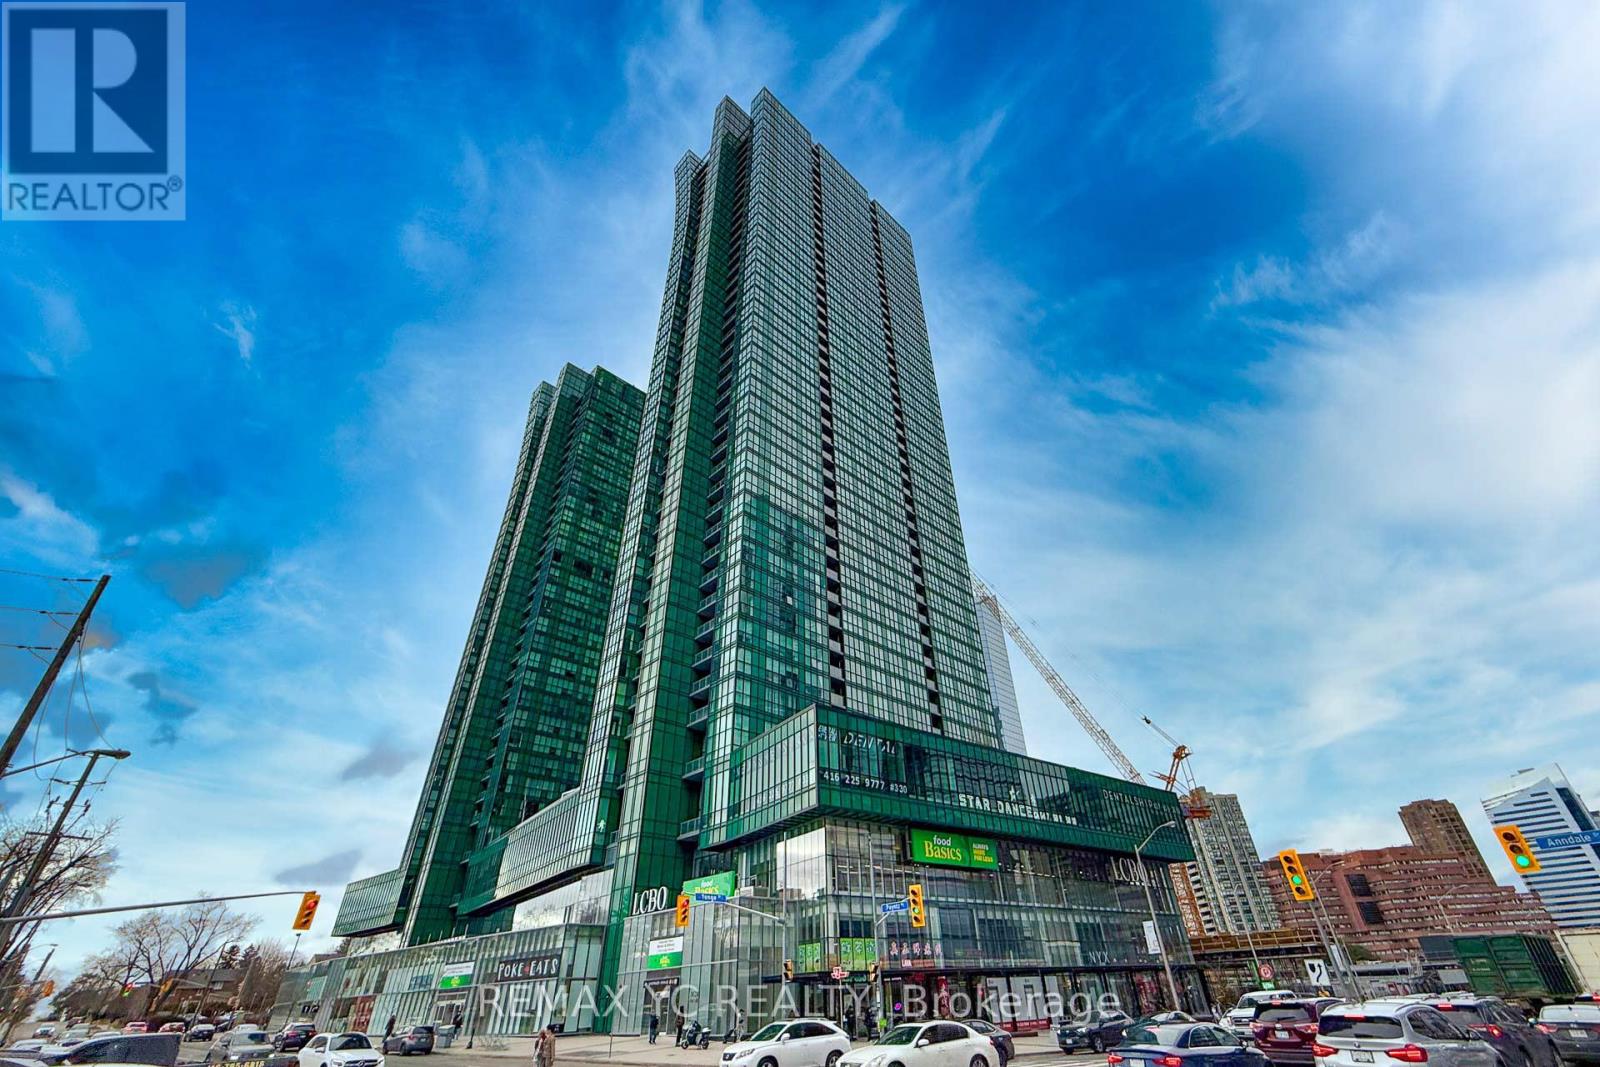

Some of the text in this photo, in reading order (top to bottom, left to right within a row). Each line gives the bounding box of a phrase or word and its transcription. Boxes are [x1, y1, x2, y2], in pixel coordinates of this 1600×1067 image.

[823, 771, 840, 782] 416
[845, 774, 860, 786] 225
[959, 793, 990, 811] STAR
[997, 800, 1034, 819] DANCE
[924, 840, 962, 861] Basics
[933, 835, 951, 846] food
[1546, 833, 1591, 847] Anndale
[1110, 856, 1149, 882] LCBO
[632, 886, 667, 915] LCBO
[497, 958, 558, 981] POKE EATS
